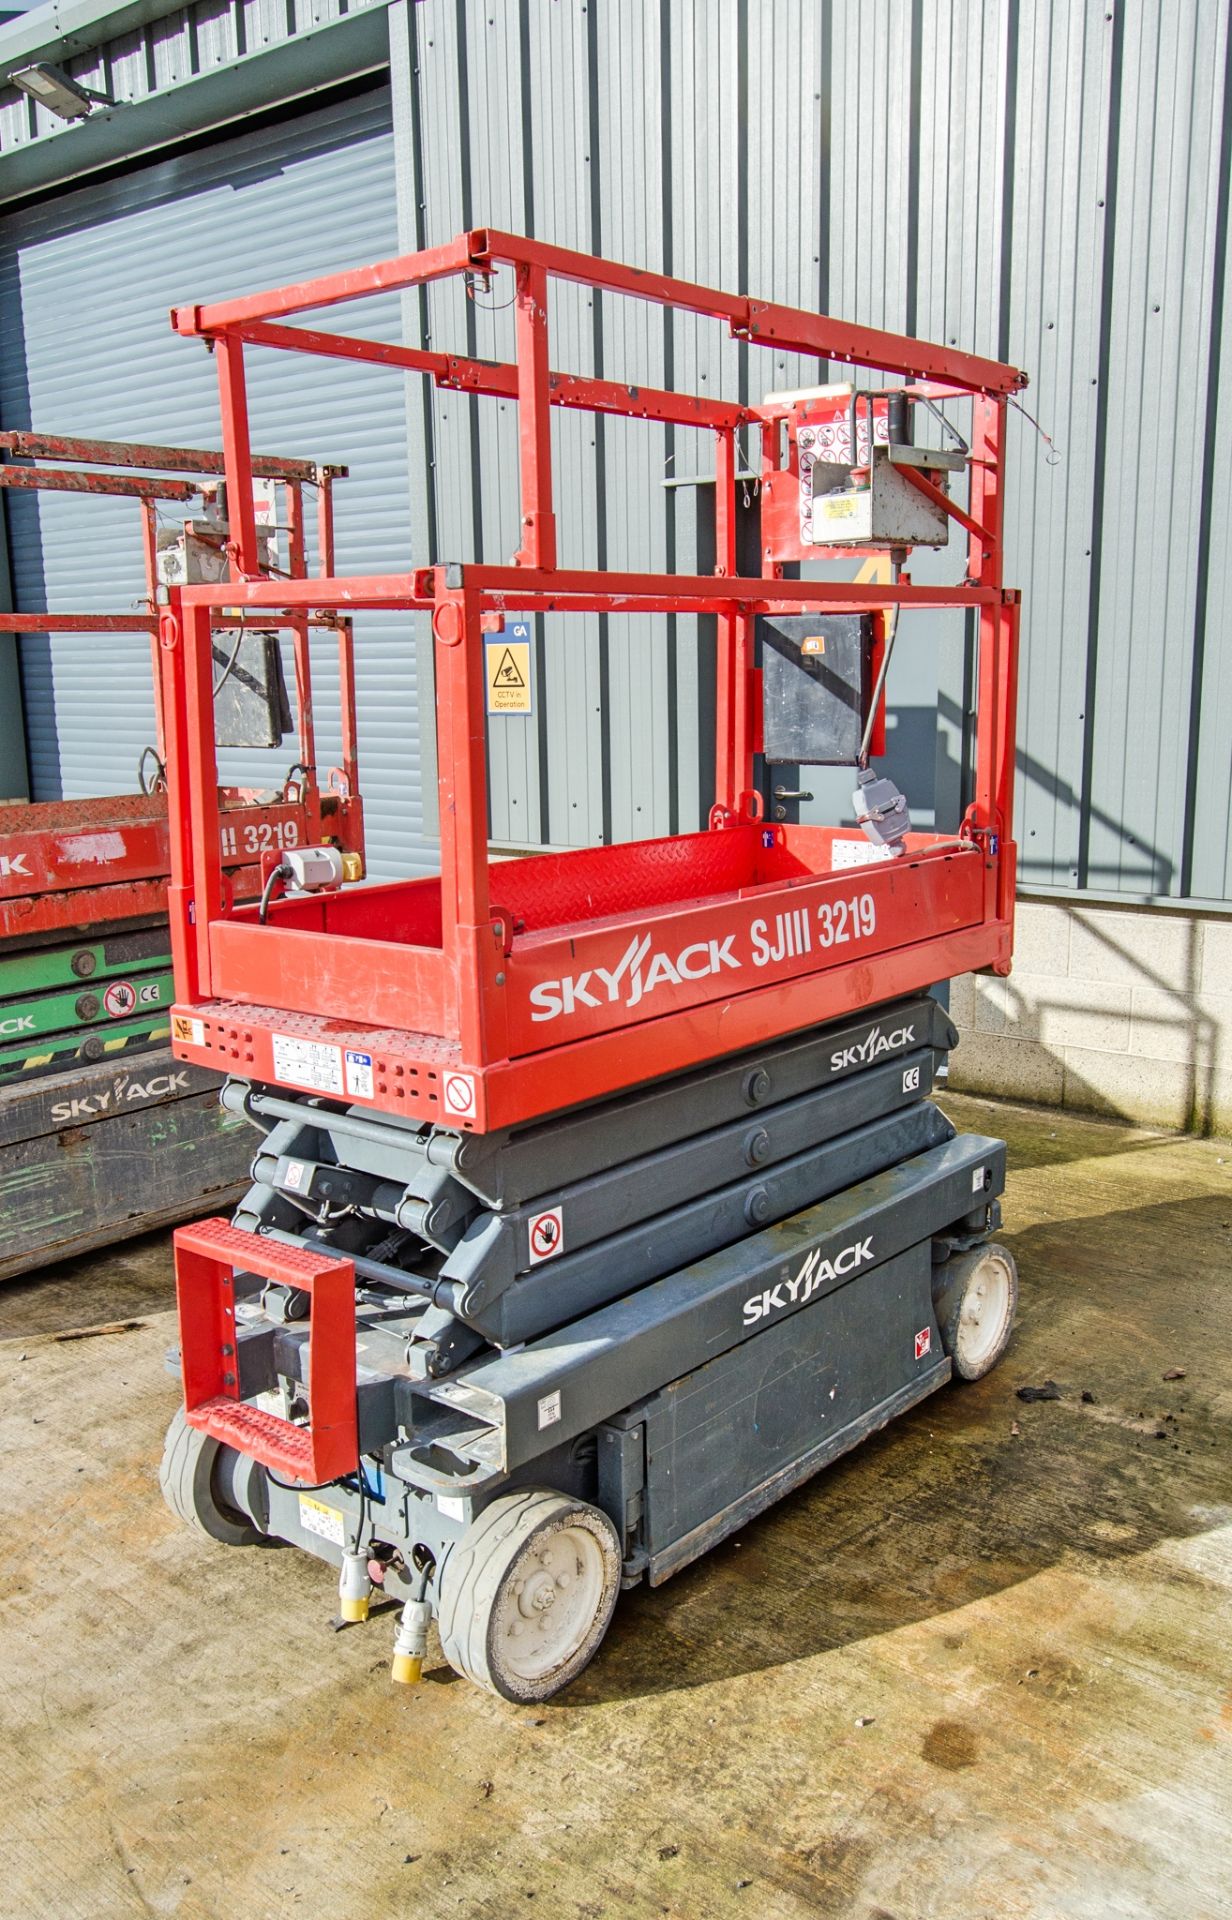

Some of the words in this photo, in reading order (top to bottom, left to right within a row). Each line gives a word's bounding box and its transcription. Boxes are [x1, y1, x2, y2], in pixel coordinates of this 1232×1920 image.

[494, 700, 524, 708] Operation
[244, 820, 298, 854] 3219
[529, 932, 742, 1021] SKYJACK
[817, 893, 875, 948] 3219
[830, 1024, 916, 1071] SKYJACK
[743, 1235, 875, 1325] SKYJACK
